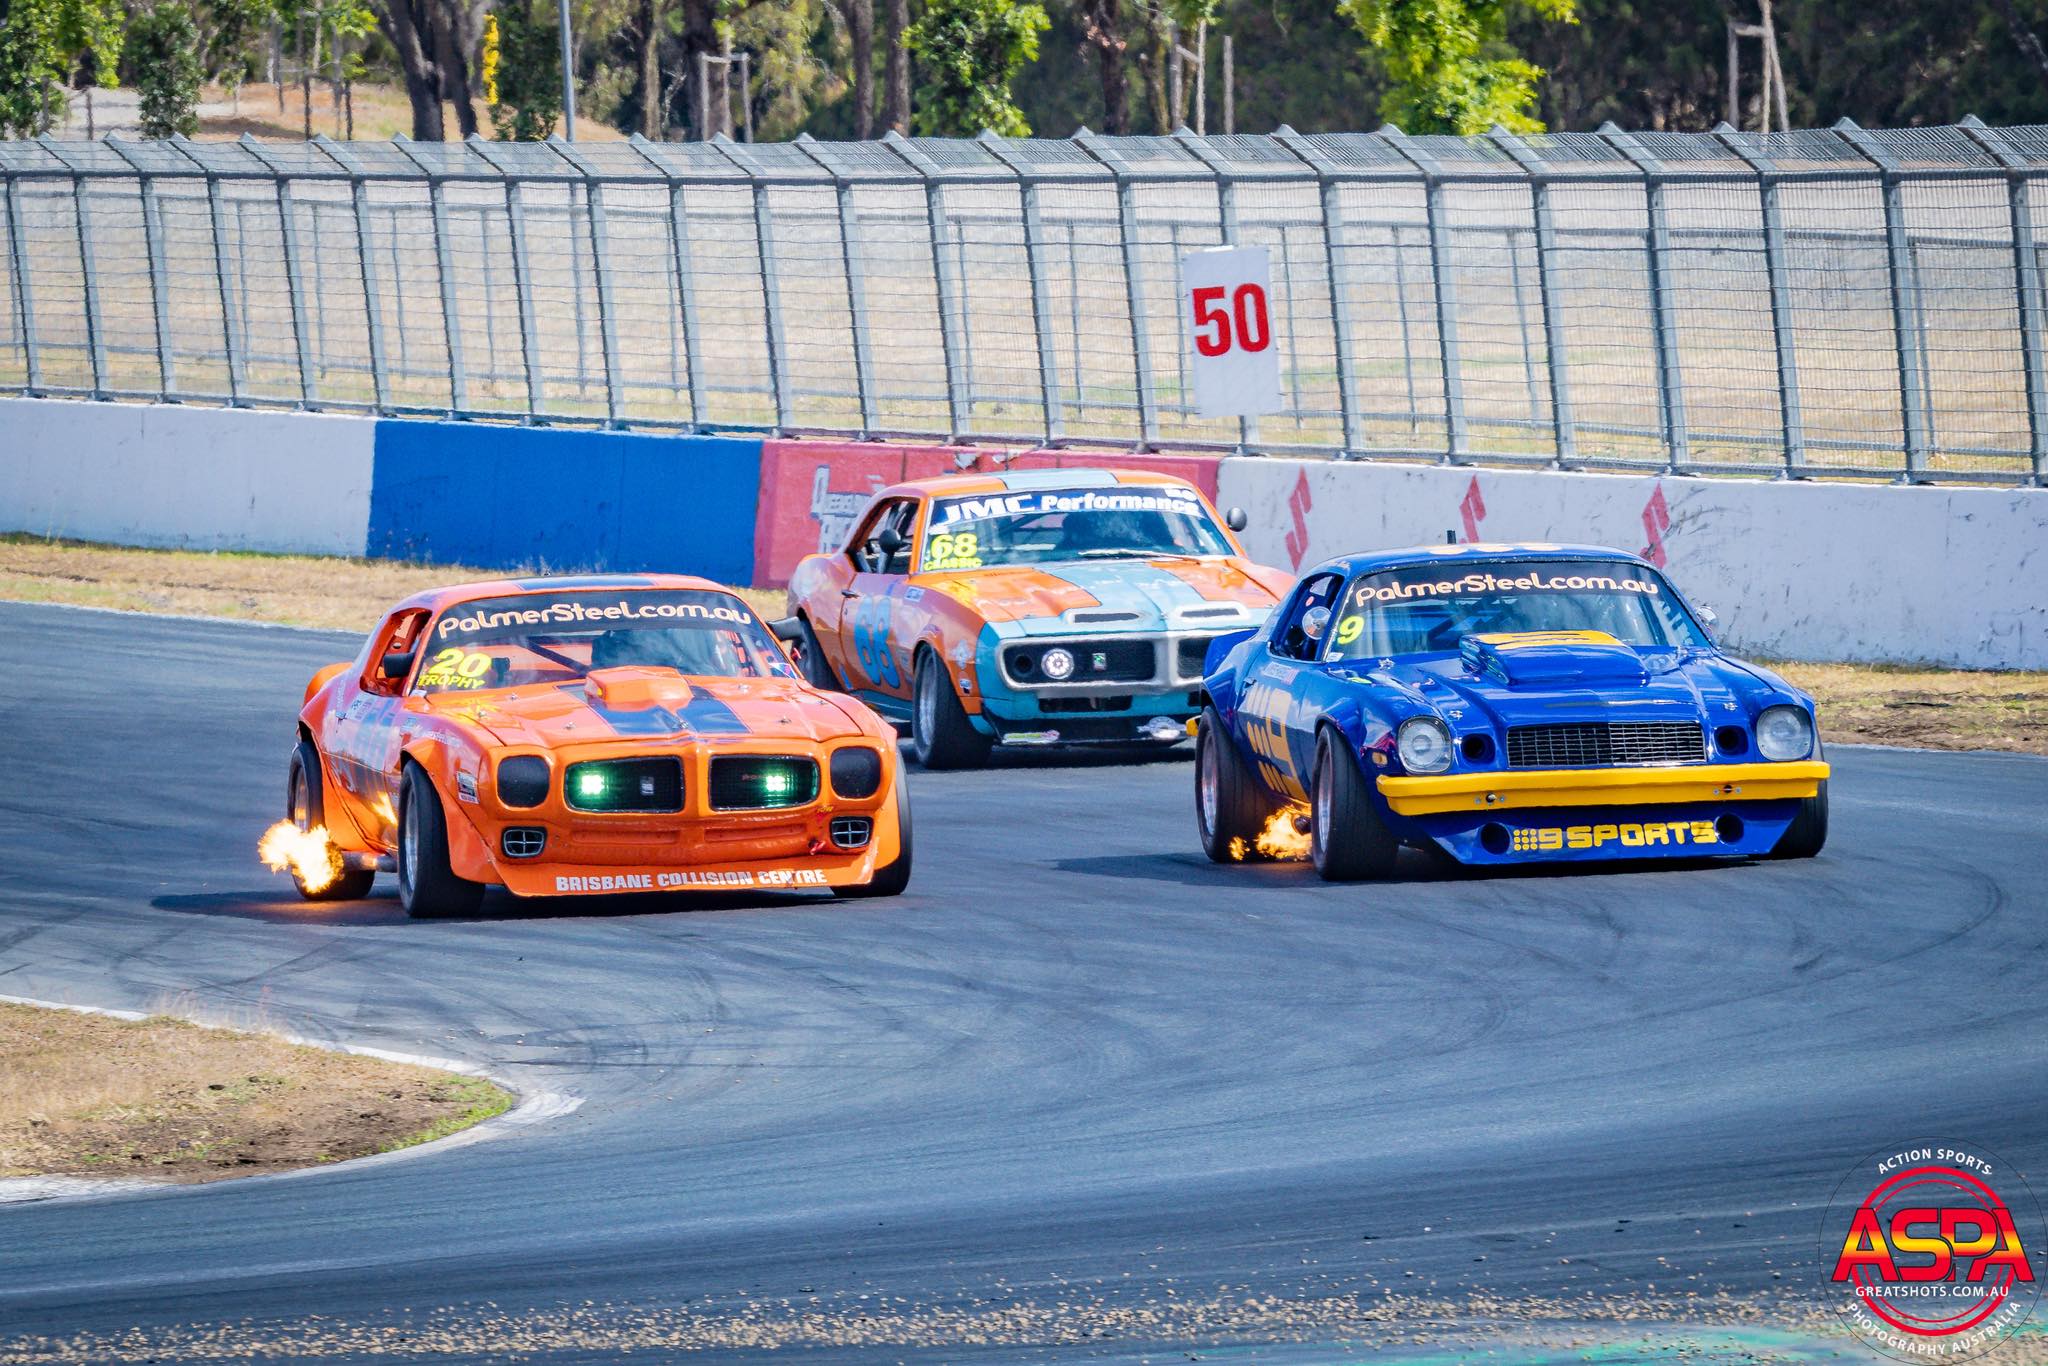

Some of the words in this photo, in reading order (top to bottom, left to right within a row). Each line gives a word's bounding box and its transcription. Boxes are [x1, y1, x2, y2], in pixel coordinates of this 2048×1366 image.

[1192, 283, 1270, 357] 50
[934, 494, 1035, 527] JMC
[1041, 493, 1199, 515] Performance
[931, 533, 978, 559] 68
[924, 557, 983, 571] CLASSIC
[1356, 572, 1659, 608] PalmerSteel.com.au
[437, 601, 751, 639] PalmerSteel.com.au
[1337, 615, 1365, 645] 9
[428, 648, 492, 678] 20
[418, 674, 486, 689] TROPHY
[1538, 827, 1564, 850] 9
[1568, 821, 1718, 848] SPORTS
[555, 875, 653, 892] BRISBANE
[657, 871, 754, 887] COLLISION
[758, 869, 828, 886] CENTRE
